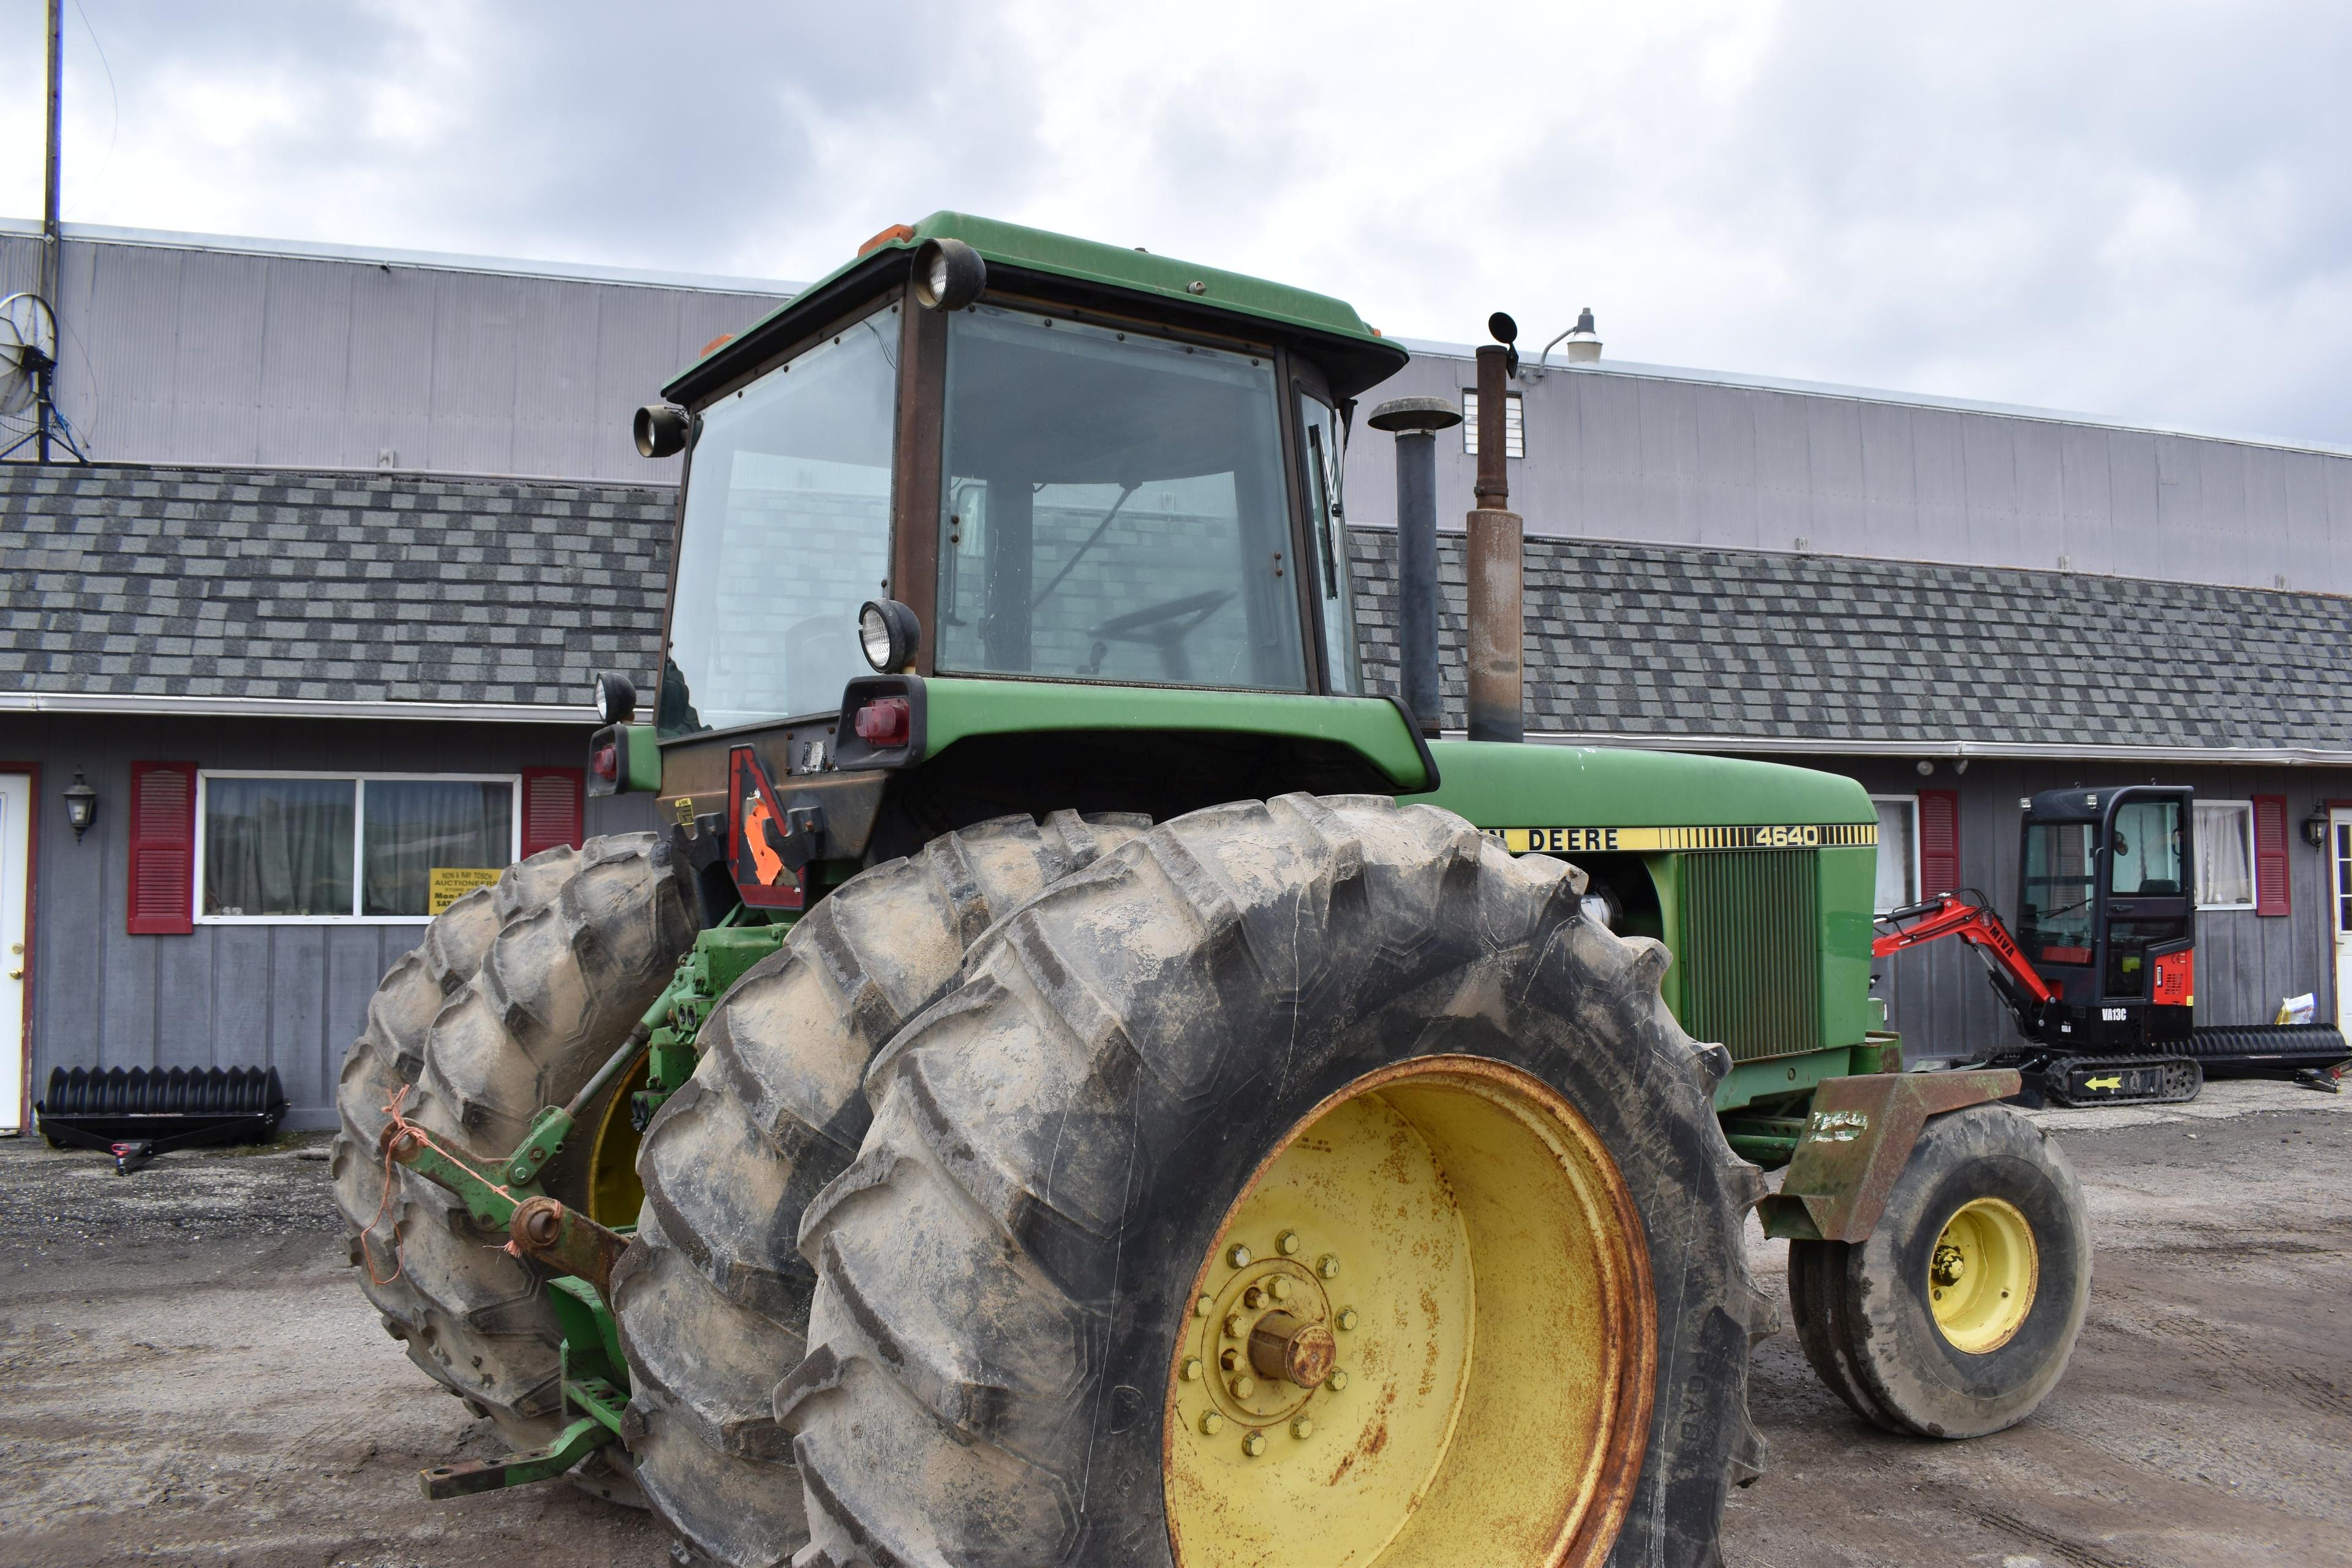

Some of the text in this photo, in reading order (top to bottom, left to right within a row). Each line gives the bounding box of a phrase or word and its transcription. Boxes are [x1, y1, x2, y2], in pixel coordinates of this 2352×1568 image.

[1529, 829, 1618, 851] DEERE
[1755, 825, 1819, 846] 4640
[1989, 925, 2015, 957] MIVA
[2101, 1008, 2127, 1020] VA13C
